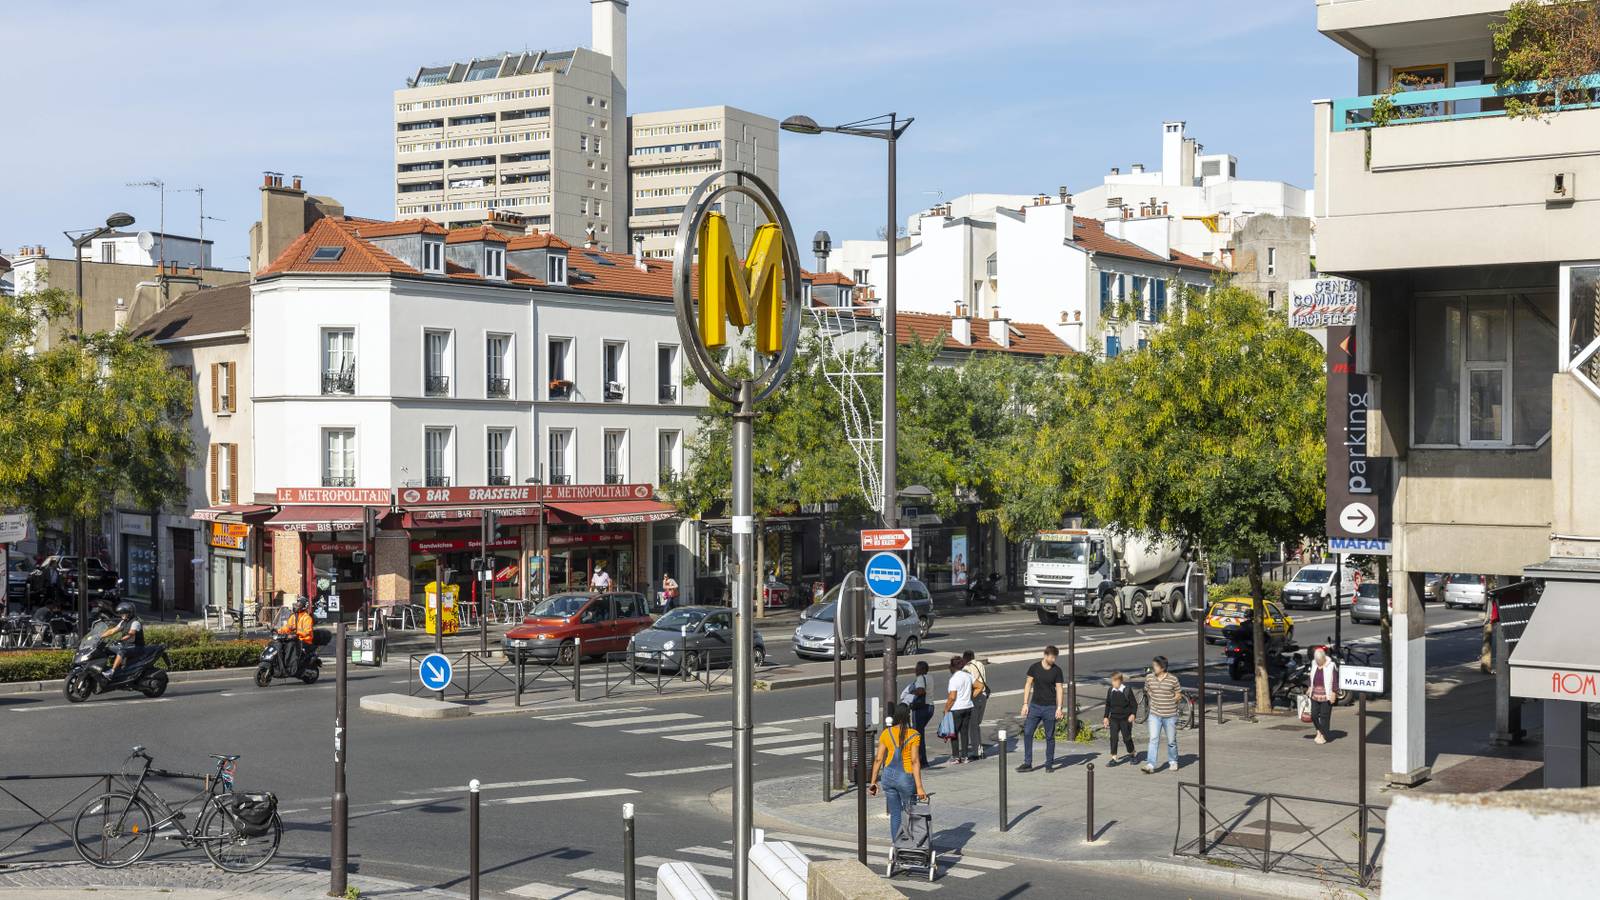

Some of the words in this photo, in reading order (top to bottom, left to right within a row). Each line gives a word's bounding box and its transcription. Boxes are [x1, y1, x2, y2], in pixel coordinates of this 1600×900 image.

[699, 211, 783, 355] M
[1343, 393, 1372, 494] parking
[278, 489, 292, 501] LE
[298, 489, 389, 502] METROPOLITAIN
[426, 489, 450, 501] BAR
[468, 488, 529, 500] BRASSERIE
[557, 486, 630, 498] METROPOLITAIN
[317, 523, 356, 532] BISTROT
[1331, 537, 1390, 550] MARAT
[1344, 678, 1377, 687] MARAT
